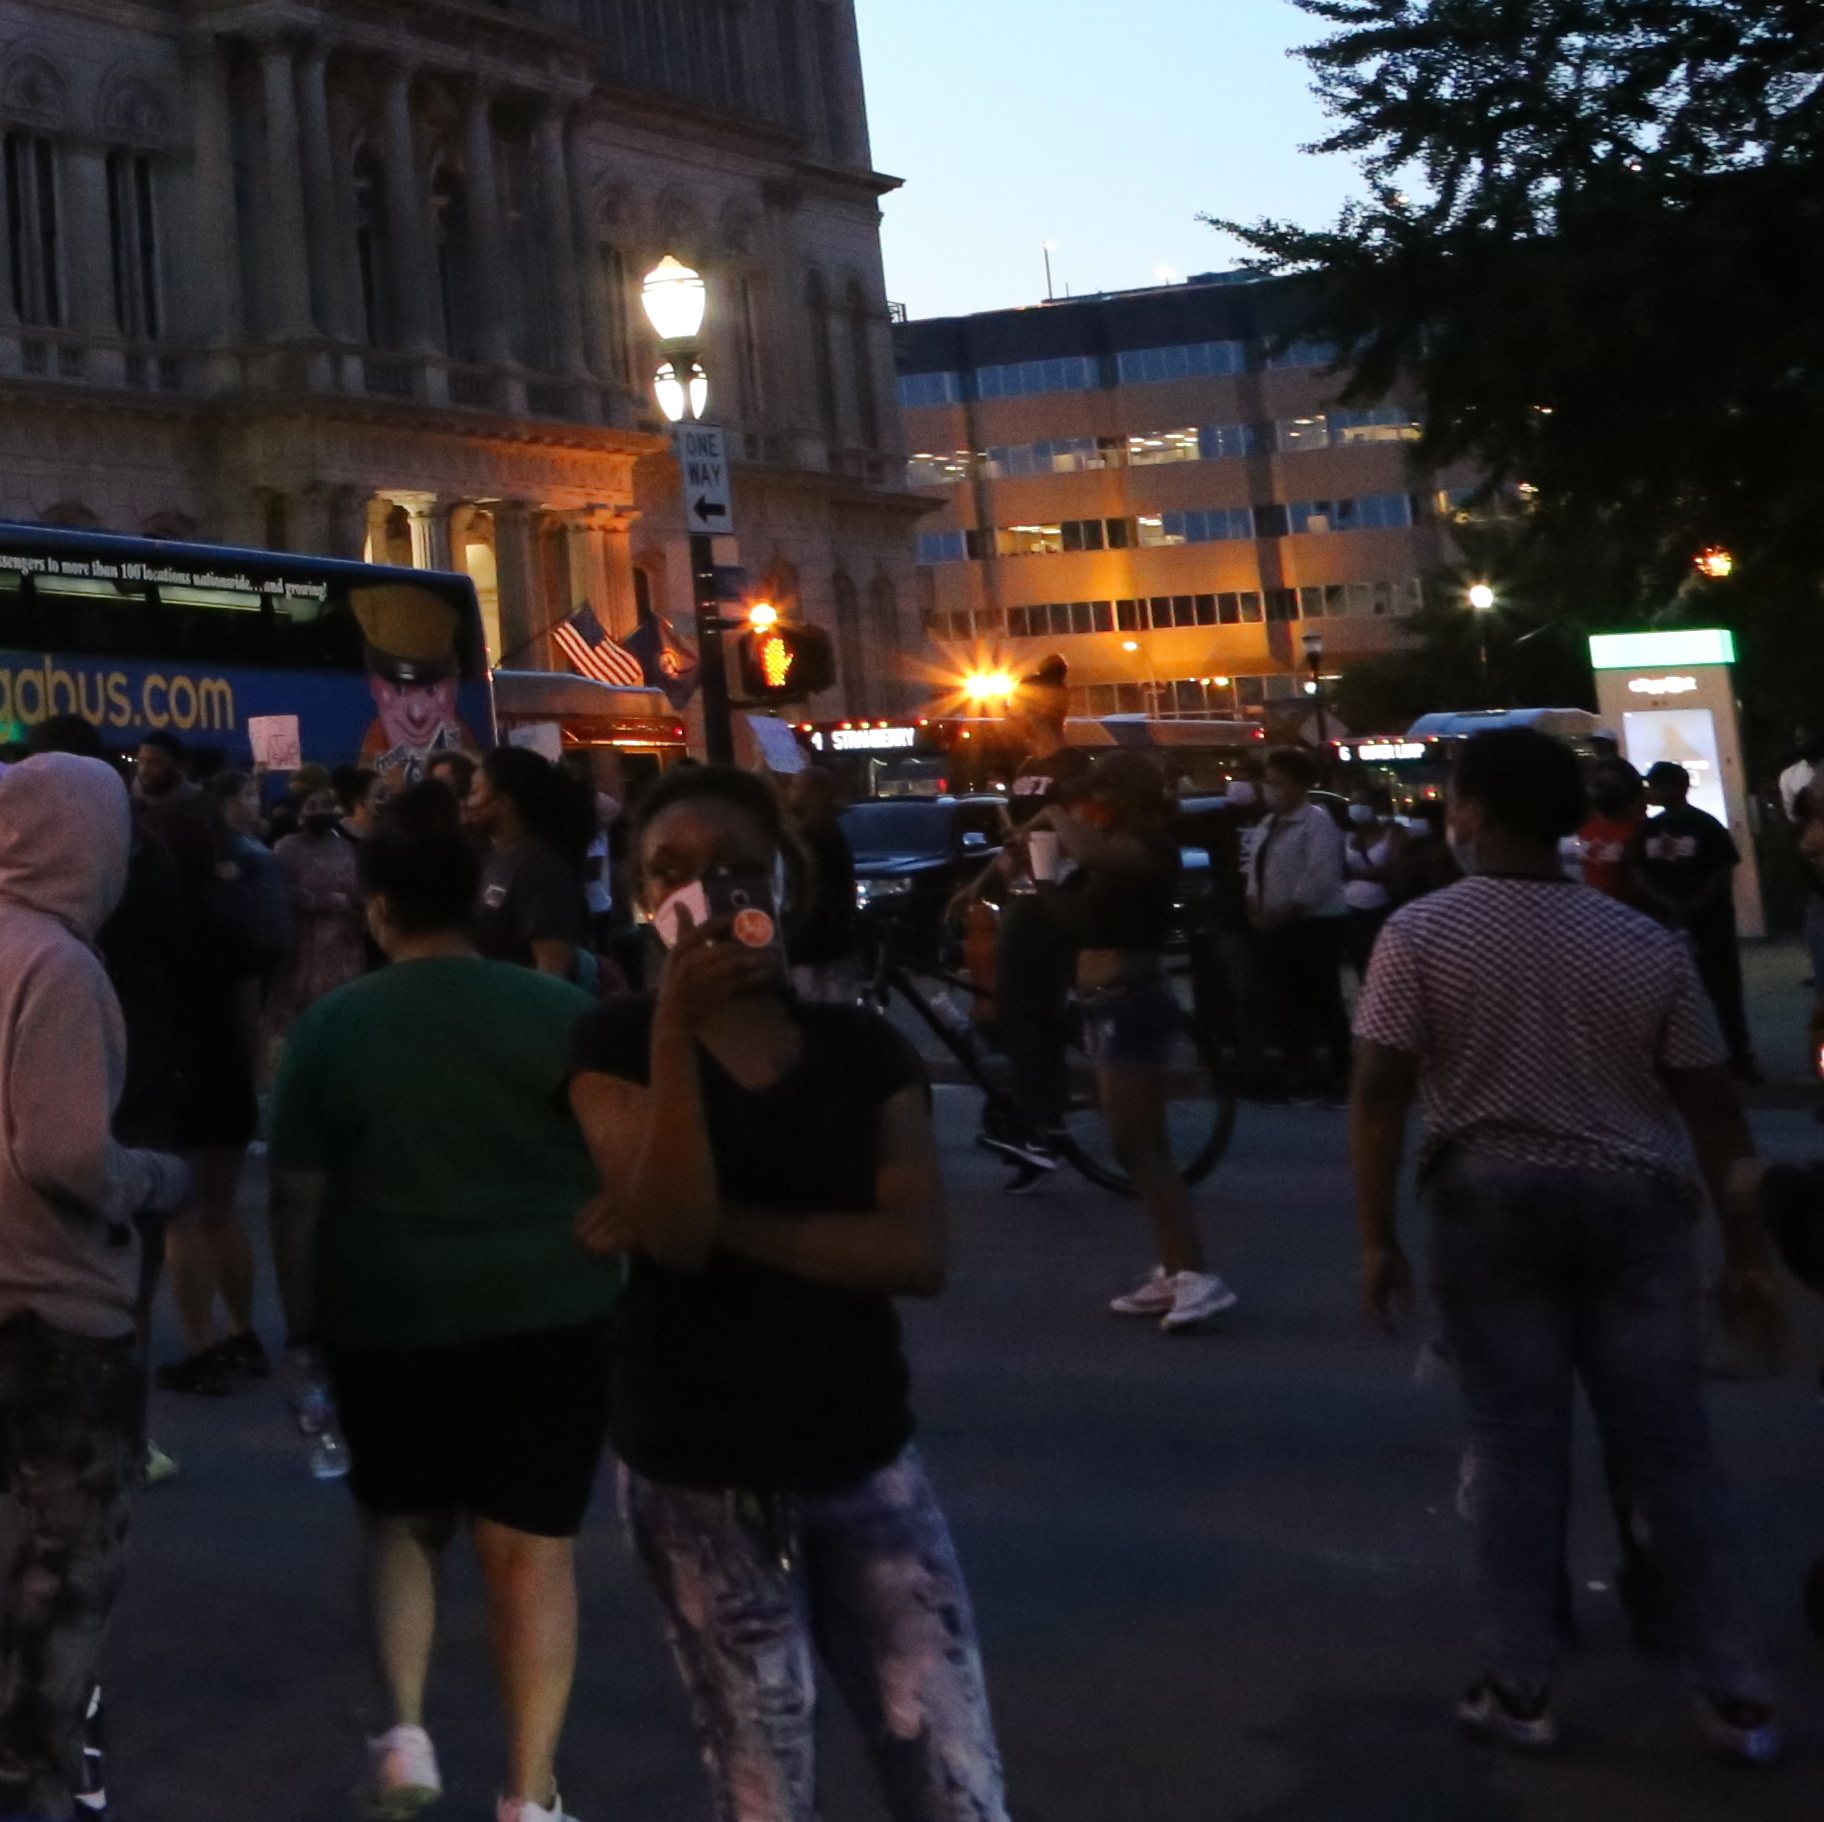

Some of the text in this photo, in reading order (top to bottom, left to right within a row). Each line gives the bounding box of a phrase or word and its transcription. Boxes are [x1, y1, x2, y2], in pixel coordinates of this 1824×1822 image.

[685, 433, 720, 457] ONE
[687, 463, 721, 487] WAY
[47, 557, 59, 572] to
[61, 561, 90, 576] more
[92, 560, 119, 578] than
[121, 563, 141, 580] 100
[142, 564, 191, 584] locations
